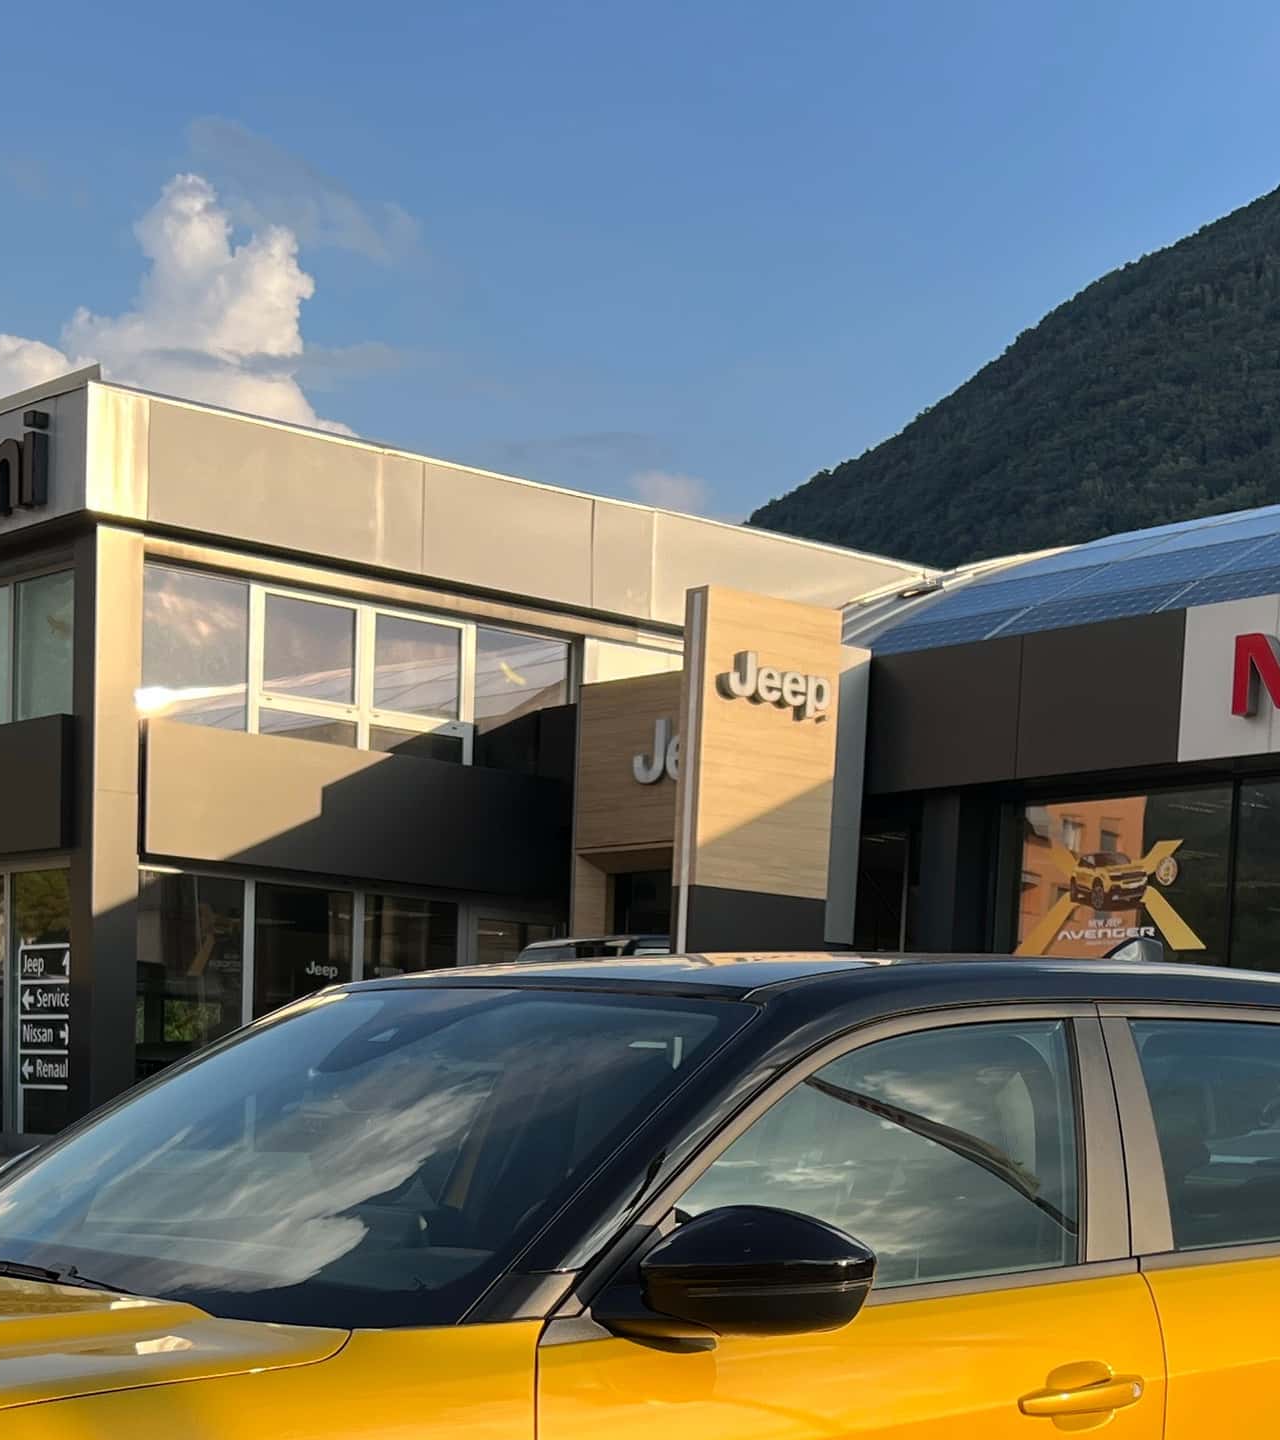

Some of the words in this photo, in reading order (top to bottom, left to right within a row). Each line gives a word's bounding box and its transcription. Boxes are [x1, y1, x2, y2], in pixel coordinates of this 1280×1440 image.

[716, 649, 831, 721] Jeep
[1057, 926, 1156, 940] AVENGER
[23, 955, 44, 976] Jeep
[305, 961, 338, 979] Jeep
[36, 988, 69, 1008] Service
[22, 1024, 53, 1043] Nissan
[36, 1058, 69, 1078] Renaul
